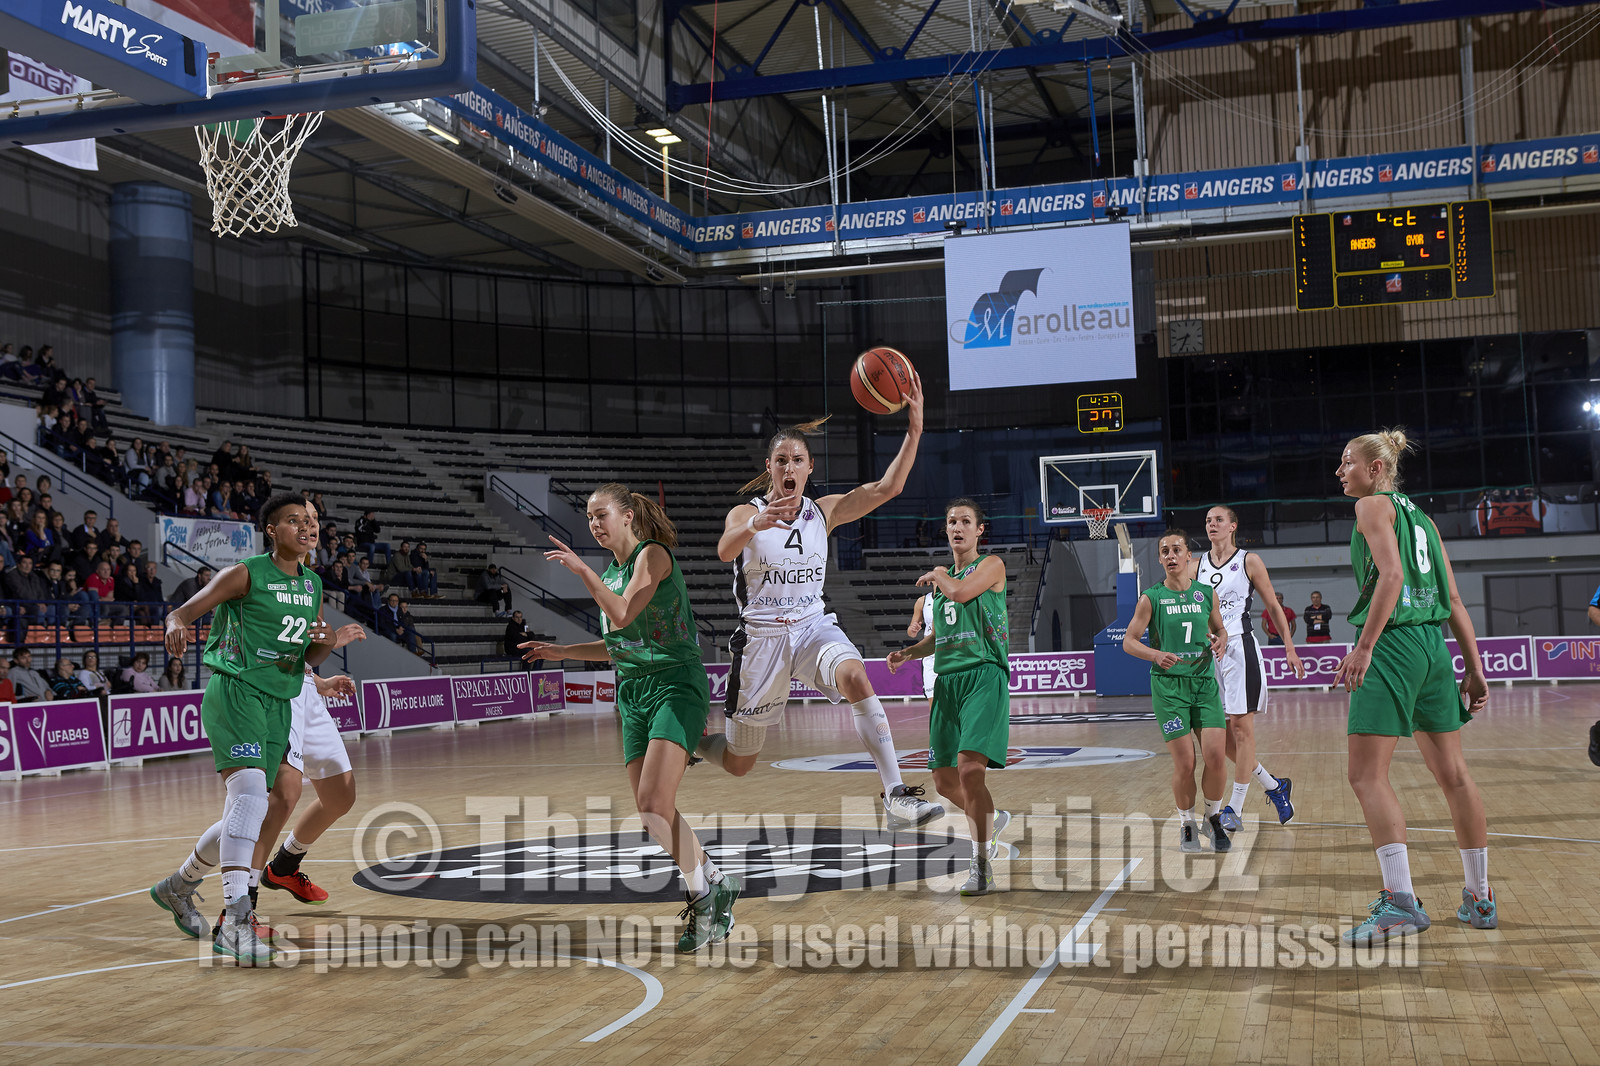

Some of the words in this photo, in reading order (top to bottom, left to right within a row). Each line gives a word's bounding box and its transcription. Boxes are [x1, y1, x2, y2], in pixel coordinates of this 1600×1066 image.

[61, 0, 137, 48] MARTY
[503, 113, 541, 149] ANGERS
[545, 140, 578, 173] ANGERS
[586, 164, 616, 196] ANGERS
[622, 186, 649, 215] ANGERS
[655, 206, 681, 233] ANGERS
[686, 223, 735, 242] ANGERS
[755, 217, 822, 238] ANGERS
[838, 209, 906, 230] ANGERS
[927, 200, 997, 222] ANGERS
[1014, 193, 1086, 214] ANGERS
[1108, 184, 1181, 207] ANGERS
[1200, 176, 1275, 198] ANGERS
[1298, 166, 1374, 190] ANGERS
[1394, 157, 1473, 181] ANGERS
[1497, 147, 1579, 171] ANGERS
[1350, 238, 1376, 250] ANGERS
[1406, 234, 1424, 246] GYOR
[950, 303, 1131, 346] Marolleau
[169, 526, 188, 534] AQUA
[168, 533, 187, 547] GYM
[784, 529, 804, 555] 4
[762, 567, 823, 585] ANGERS
[1210, 572, 1223, 589] 9
[276, 591, 292, 604] UNI
[1219, 600, 1235, 609] RS
[944, 601, 957, 625] 5
[1166, 605, 1181, 615] UNI
[277, 615, 307, 645] 22
[1182, 622, 1192, 643] 7
[455, 680, 491, 698] ESPACE
[493, 677, 527, 700] ANJOU
[1007, 673, 1088, 690] UTEAU
[391, 697, 408, 710] PAYS
[409, 697, 418, 708] DE
[419, 696, 427, 707] LA
[429, 694, 444, 706] LOIRE
[485, 706, 503, 716] ANGERS
[47, 728, 90, 743] UFAB49
